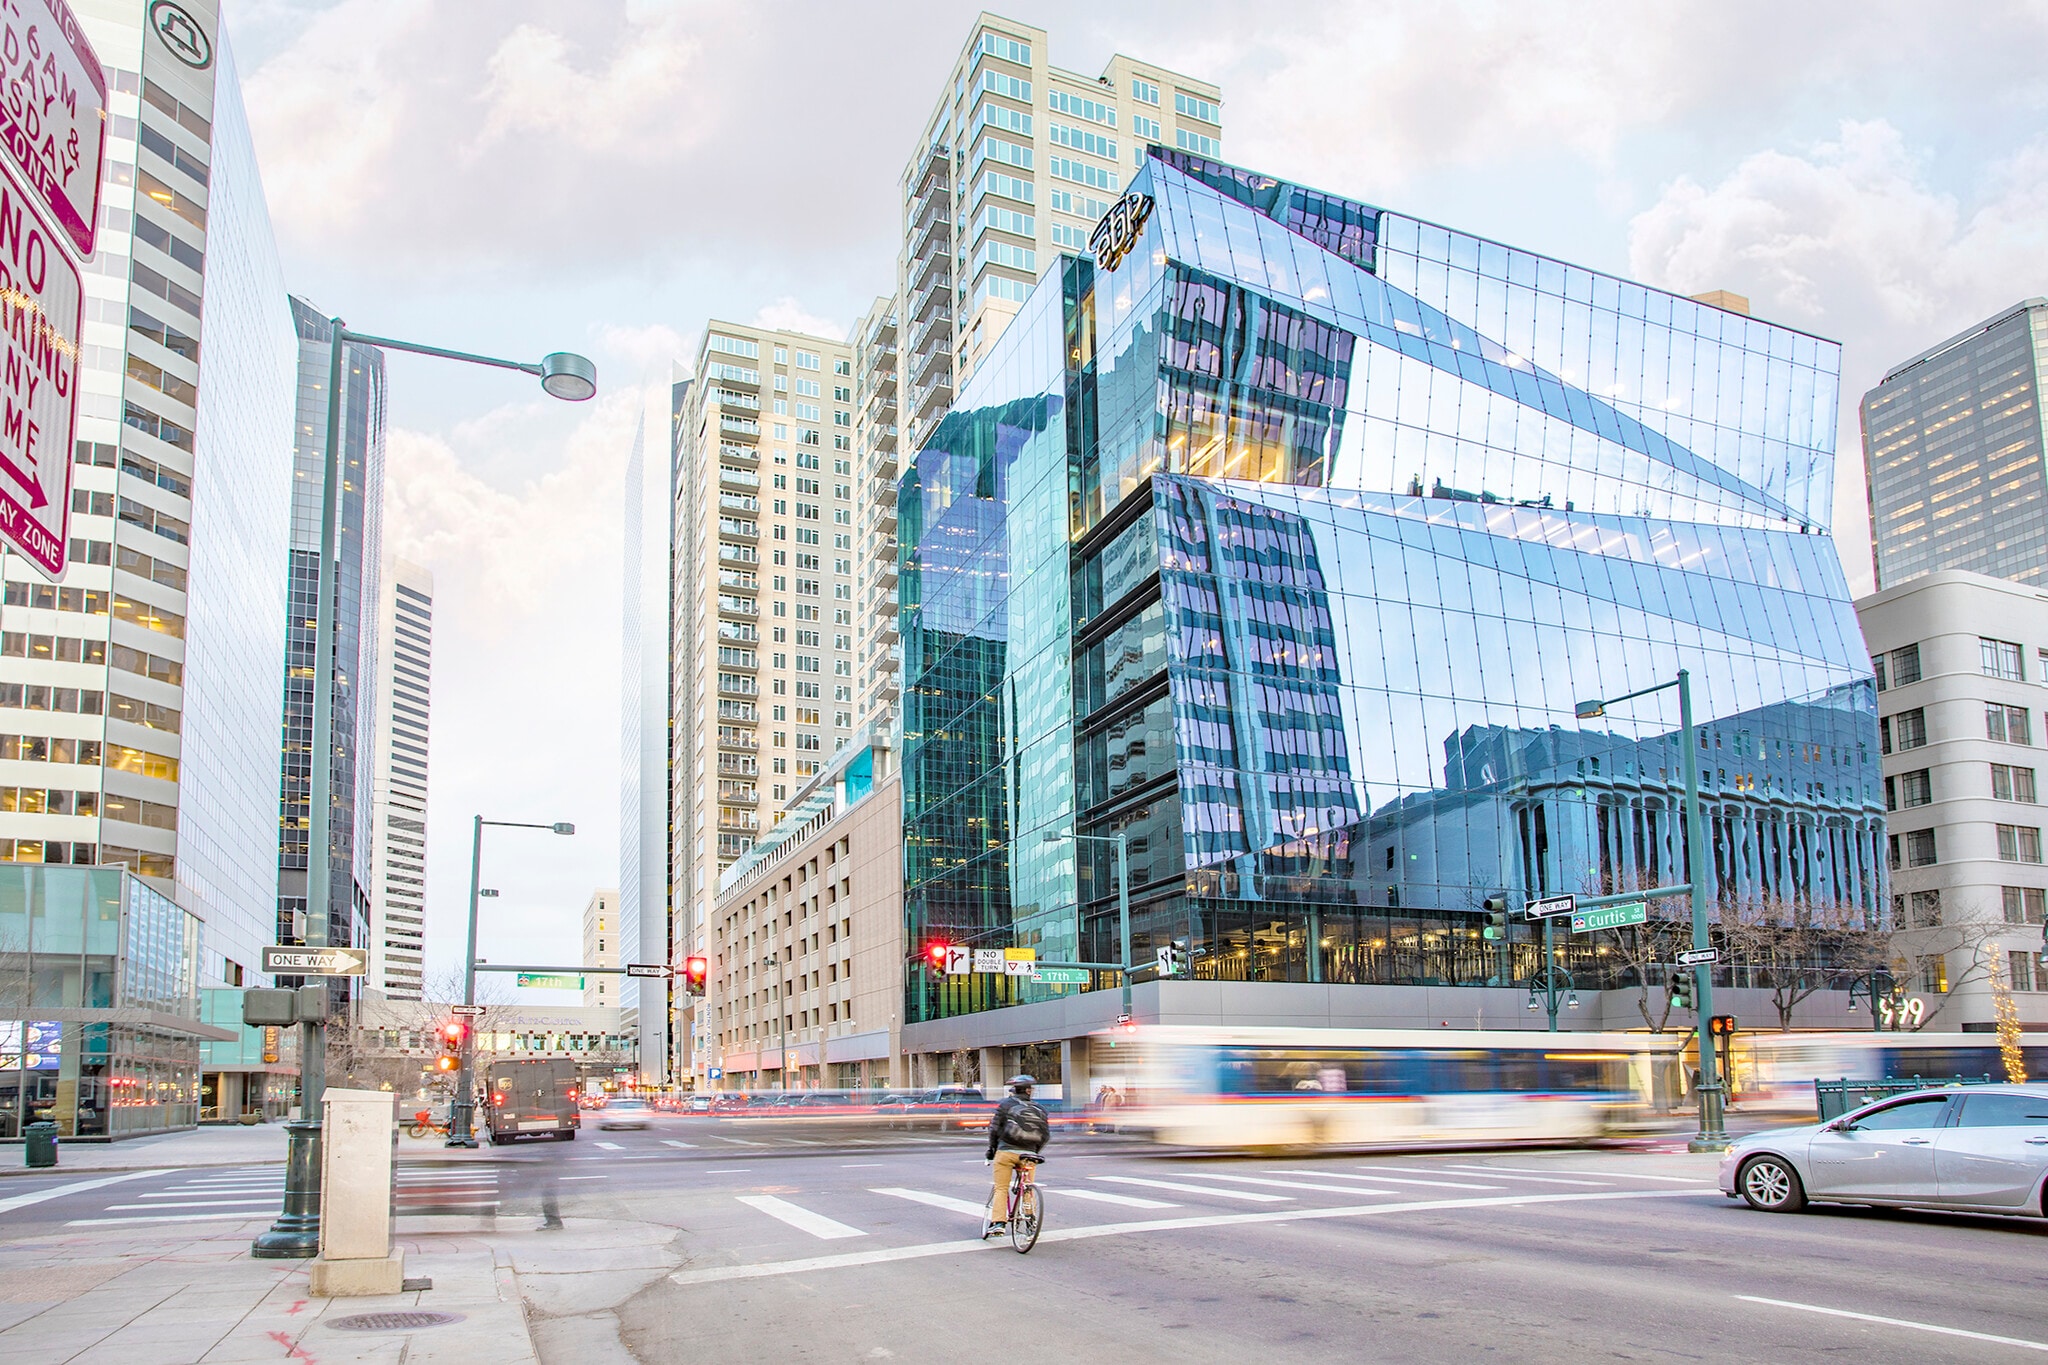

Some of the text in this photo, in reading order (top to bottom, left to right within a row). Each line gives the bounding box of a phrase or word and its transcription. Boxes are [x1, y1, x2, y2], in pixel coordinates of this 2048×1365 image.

[0, 107, 53, 204] ZONE
[67, 128, 80, 169] &
[0, 186, 46, 294] NO
[23, 518, 59, 568] ZONE
[1540, 900, 1569, 913] ONE WAY
[1588, 910, 1626, 927] Curtis
[273, 954, 335, 966] ONE WAY
[536, 977, 562, 986] 17th
[1047, 972, 1070, 981] 17th
